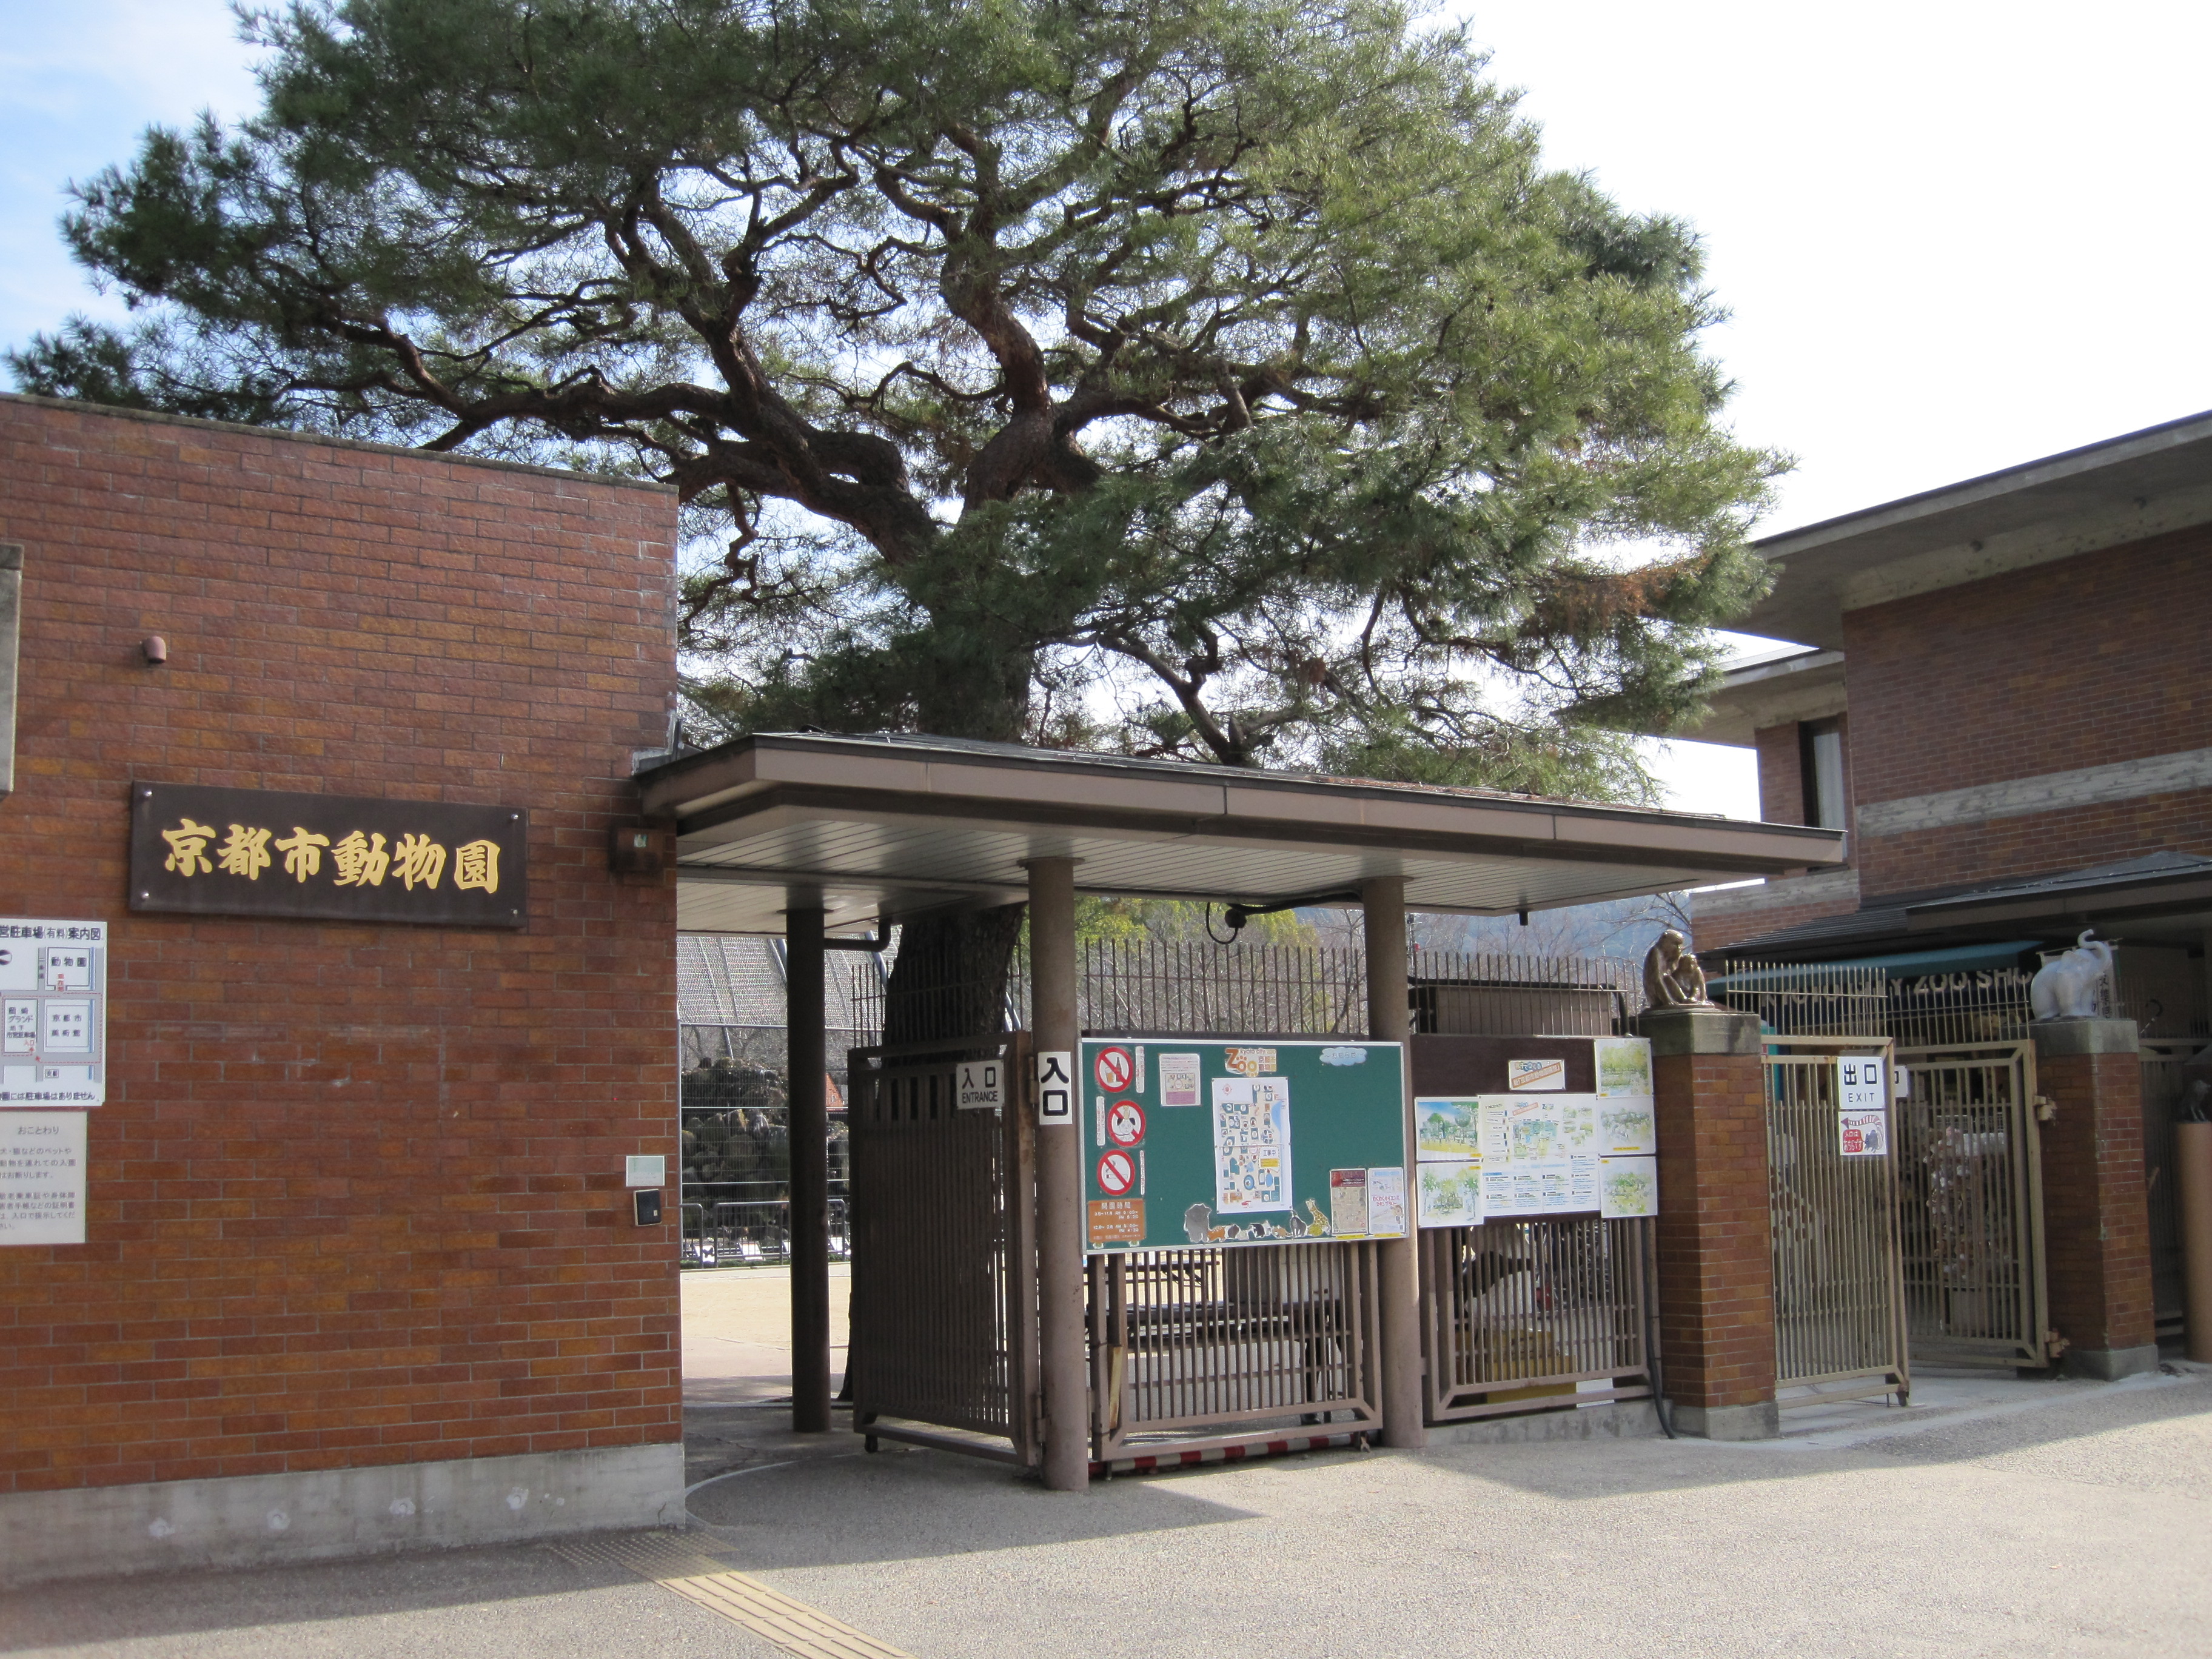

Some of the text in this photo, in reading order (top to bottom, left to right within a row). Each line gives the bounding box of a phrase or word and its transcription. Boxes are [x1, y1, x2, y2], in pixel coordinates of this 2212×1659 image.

[161, 819, 500, 894] 京都市動物園
[1977, 967, 2033, 989] SHO
[962, 1067, 996, 1089] 入口
[1843, 1064, 1877, 1085] 出口
[0, 1091, 99, 1101] 園には駐車場はありません。
[1040, 1057, 1070, 1116] 入口
[1848, 1092, 1875, 1102] EXIT
[962, 1091, 998, 1104] ENTRANCE
[18, 1126, 59, 1135] おことわり
